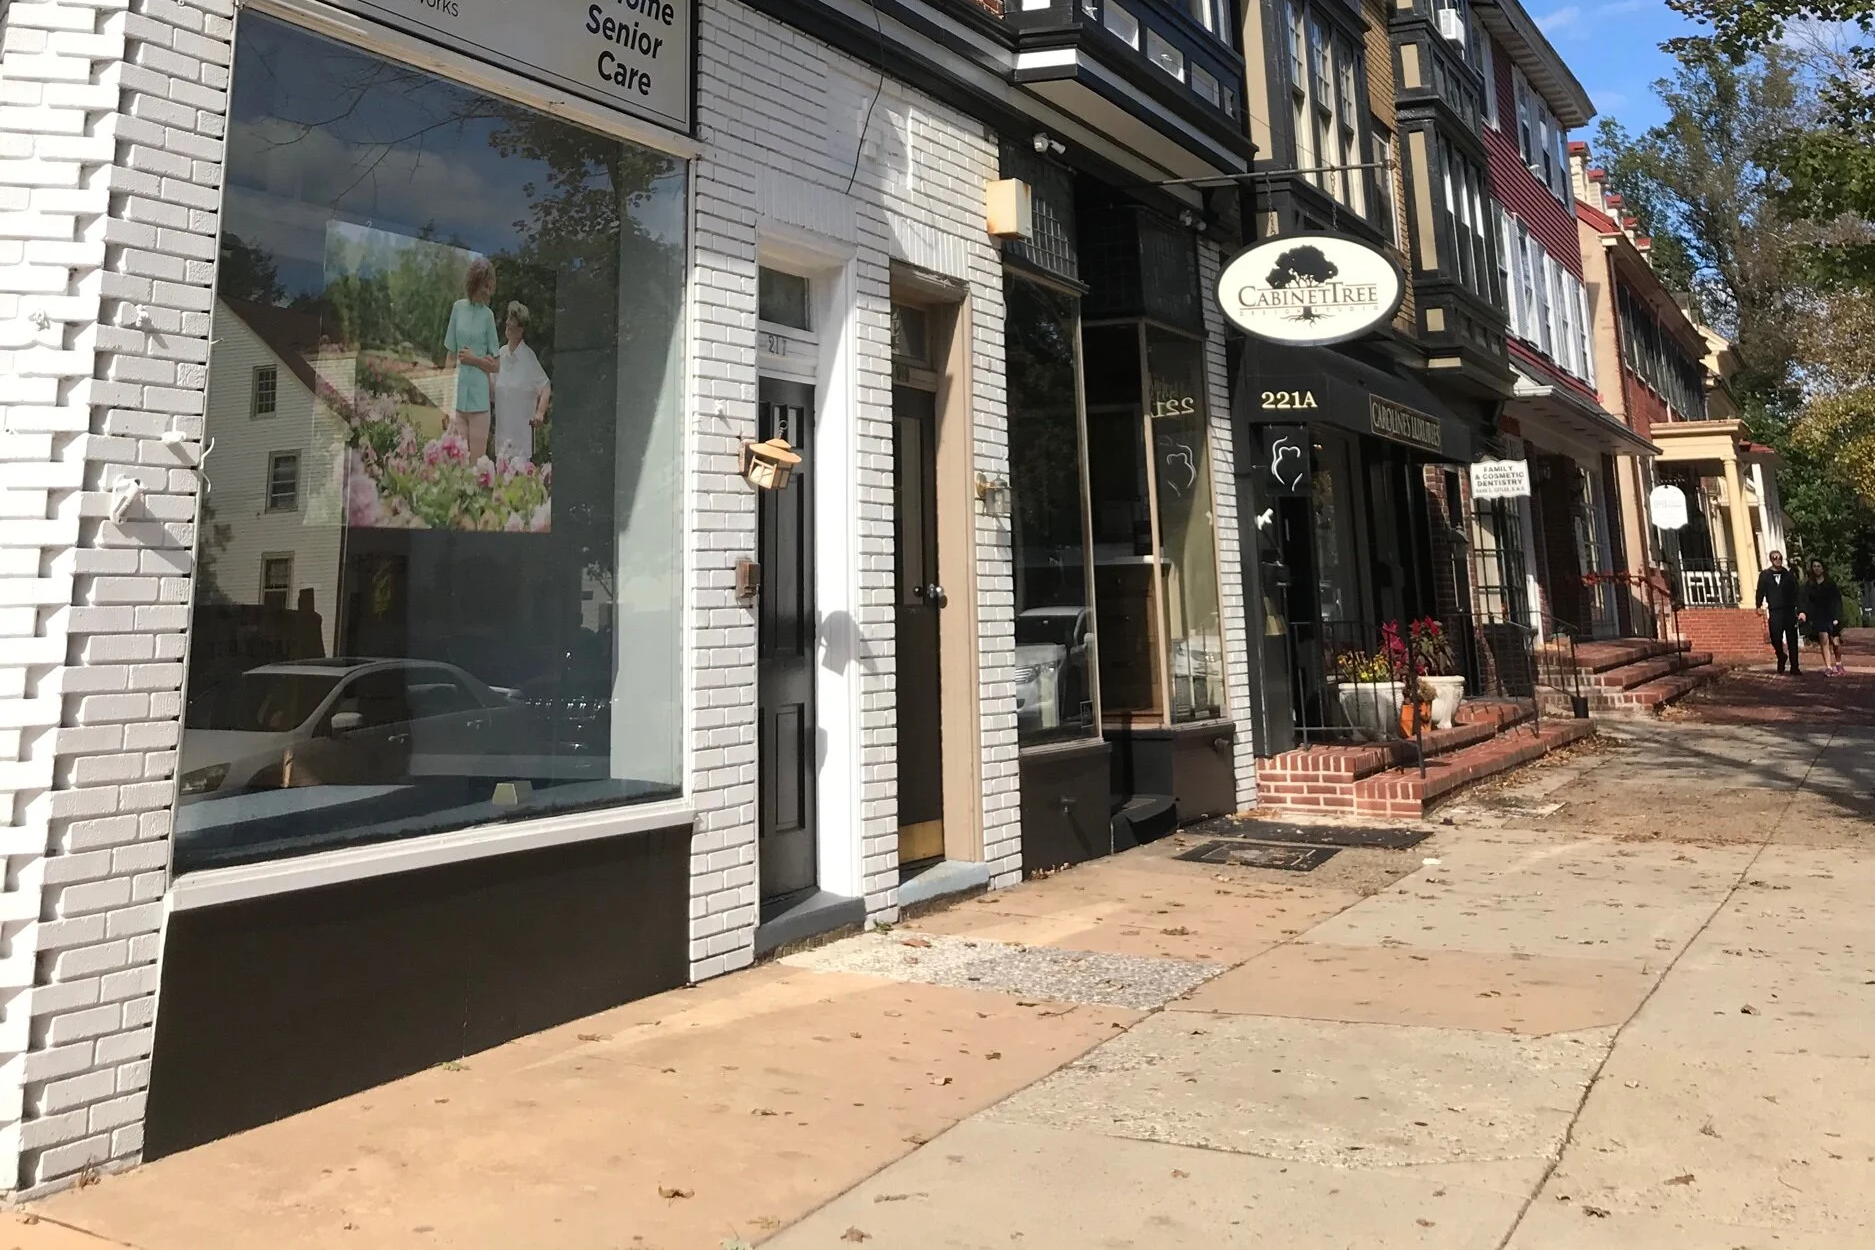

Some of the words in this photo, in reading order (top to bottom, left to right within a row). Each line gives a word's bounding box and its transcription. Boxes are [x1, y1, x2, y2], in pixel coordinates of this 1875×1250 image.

[585, 3, 663, 59] Senior
[597, 50, 652, 96] Care
[1261, 391, 1318, 409] 221A
